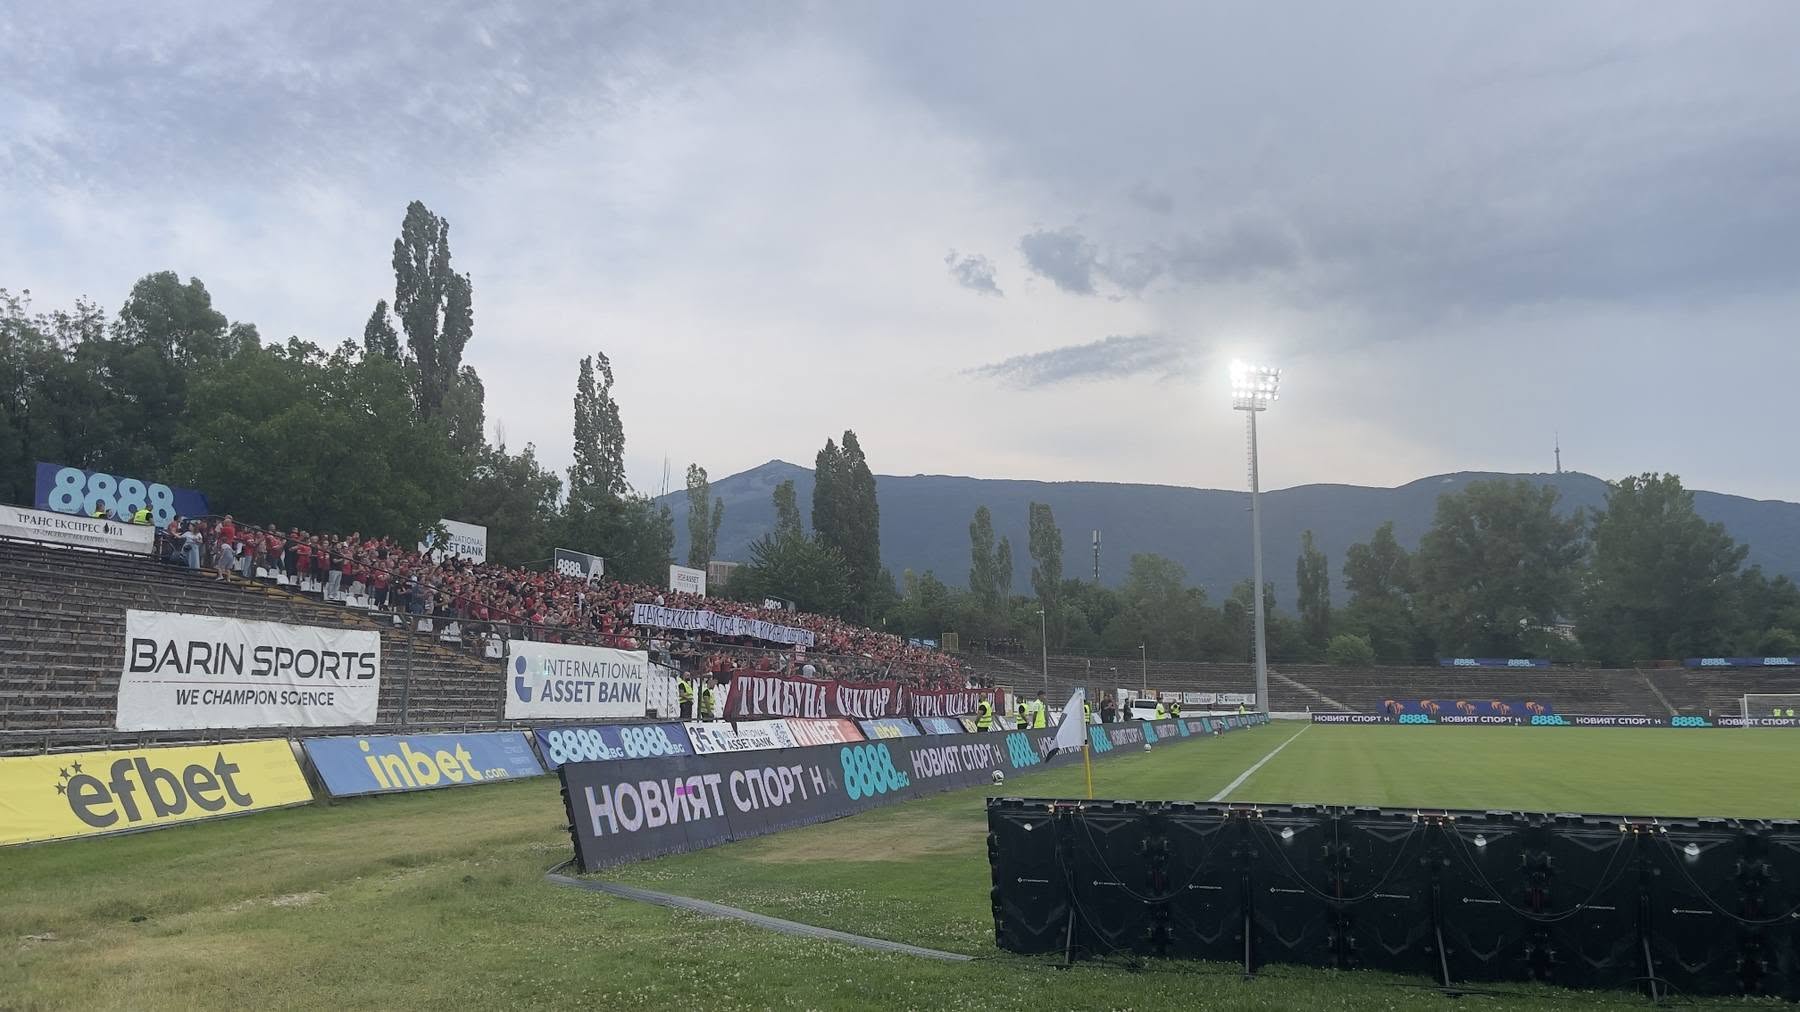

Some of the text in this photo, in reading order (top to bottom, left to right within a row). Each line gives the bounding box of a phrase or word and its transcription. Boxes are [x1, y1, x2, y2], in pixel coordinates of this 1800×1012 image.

[49, 467, 176, 528] 8888
[17, 513, 54, 527] ТРАНС
[55, 519, 100, 534] ЕКСПРЕС
[461, 544, 483, 556] BANK
[129, 638, 376, 680] BARIN SPORTS
[544, 658, 642, 680] INTERNATIONAL
[176, 689, 334, 706] WE CHAMPION SCIENCE
[540, 679, 641, 702] ASSET BANK
[738, 676, 827, 718] ТРИБУНА
[1314, 714, 1349, 722] НОВИЯТ
[1352, 714, 1382, 722] СПОРТ
[1441, 715, 1478, 723] НОВИЯТ
[1481, 715, 1512, 723] СПОРТ
[1576, 717, 1616, 725] НОВИЯТ
[1618, 717, 1651, 725] СПОРТ
[1761, 718, 1796, 726] СПОРТ
[727, 736, 775, 751] ASSET BANK
[787, 720, 846, 746] WINBET
[67, 752, 253, 828] efbet
[585, 773, 724, 837] НОВИЯТ
[729, 764, 808, 813] СПОРТ
[910, 746, 963, 779] НОВИЯТ
[960, 743, 995, 771] СПОРТ
